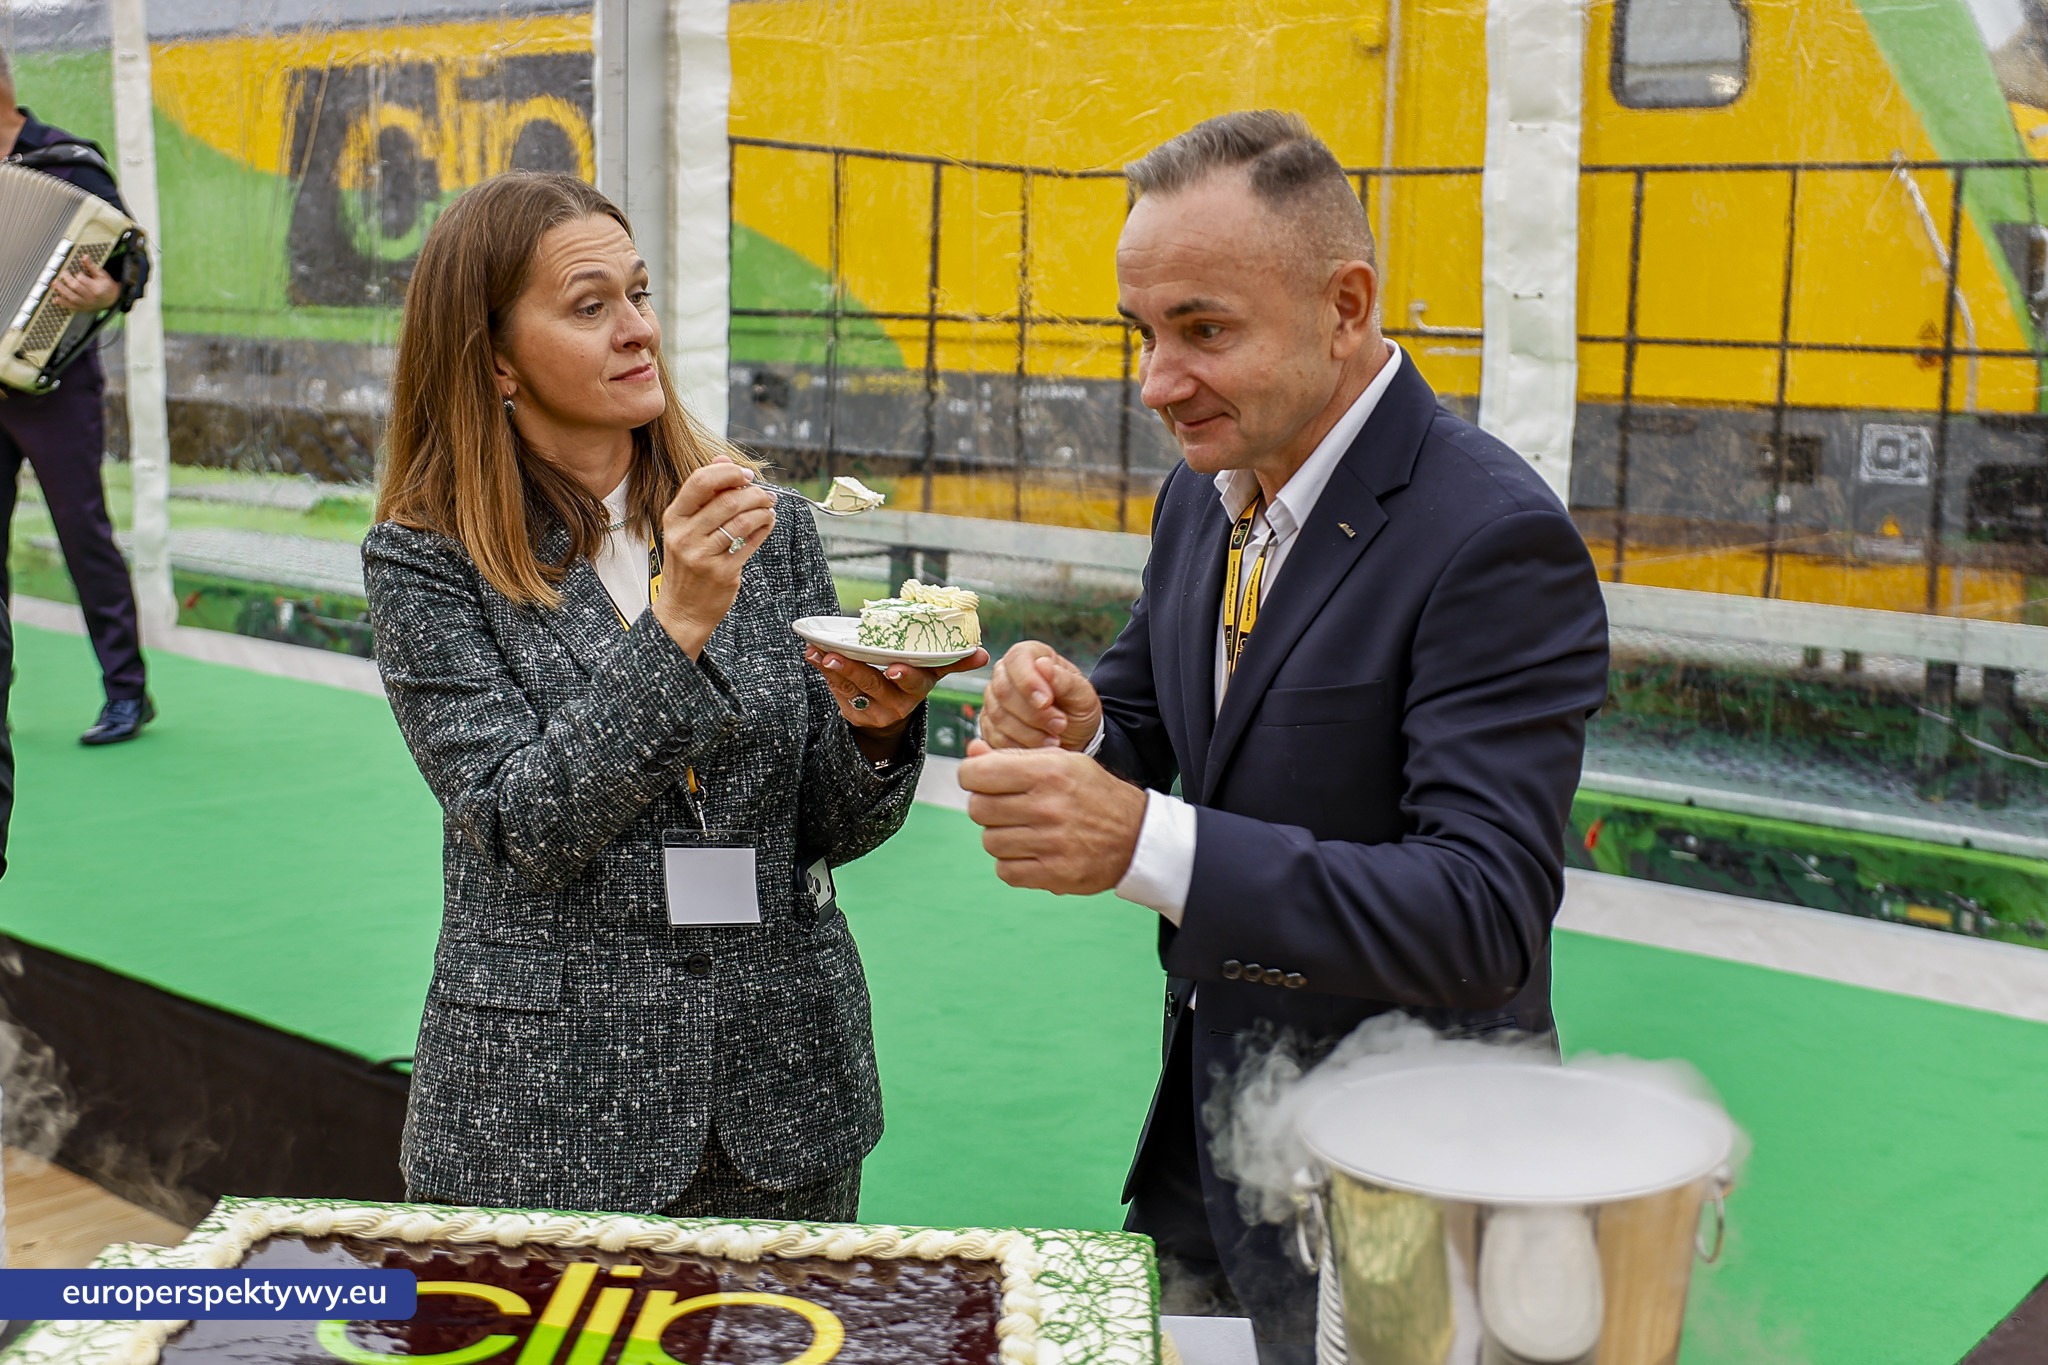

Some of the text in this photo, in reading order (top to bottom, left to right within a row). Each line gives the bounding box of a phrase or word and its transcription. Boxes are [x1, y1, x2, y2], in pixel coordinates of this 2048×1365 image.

[1232, 523, 1248, 545] clip
[1228, 560, 1236, 614] www.clip-group.com
[1246, 567, 1258, 622] www.clip-group.com
